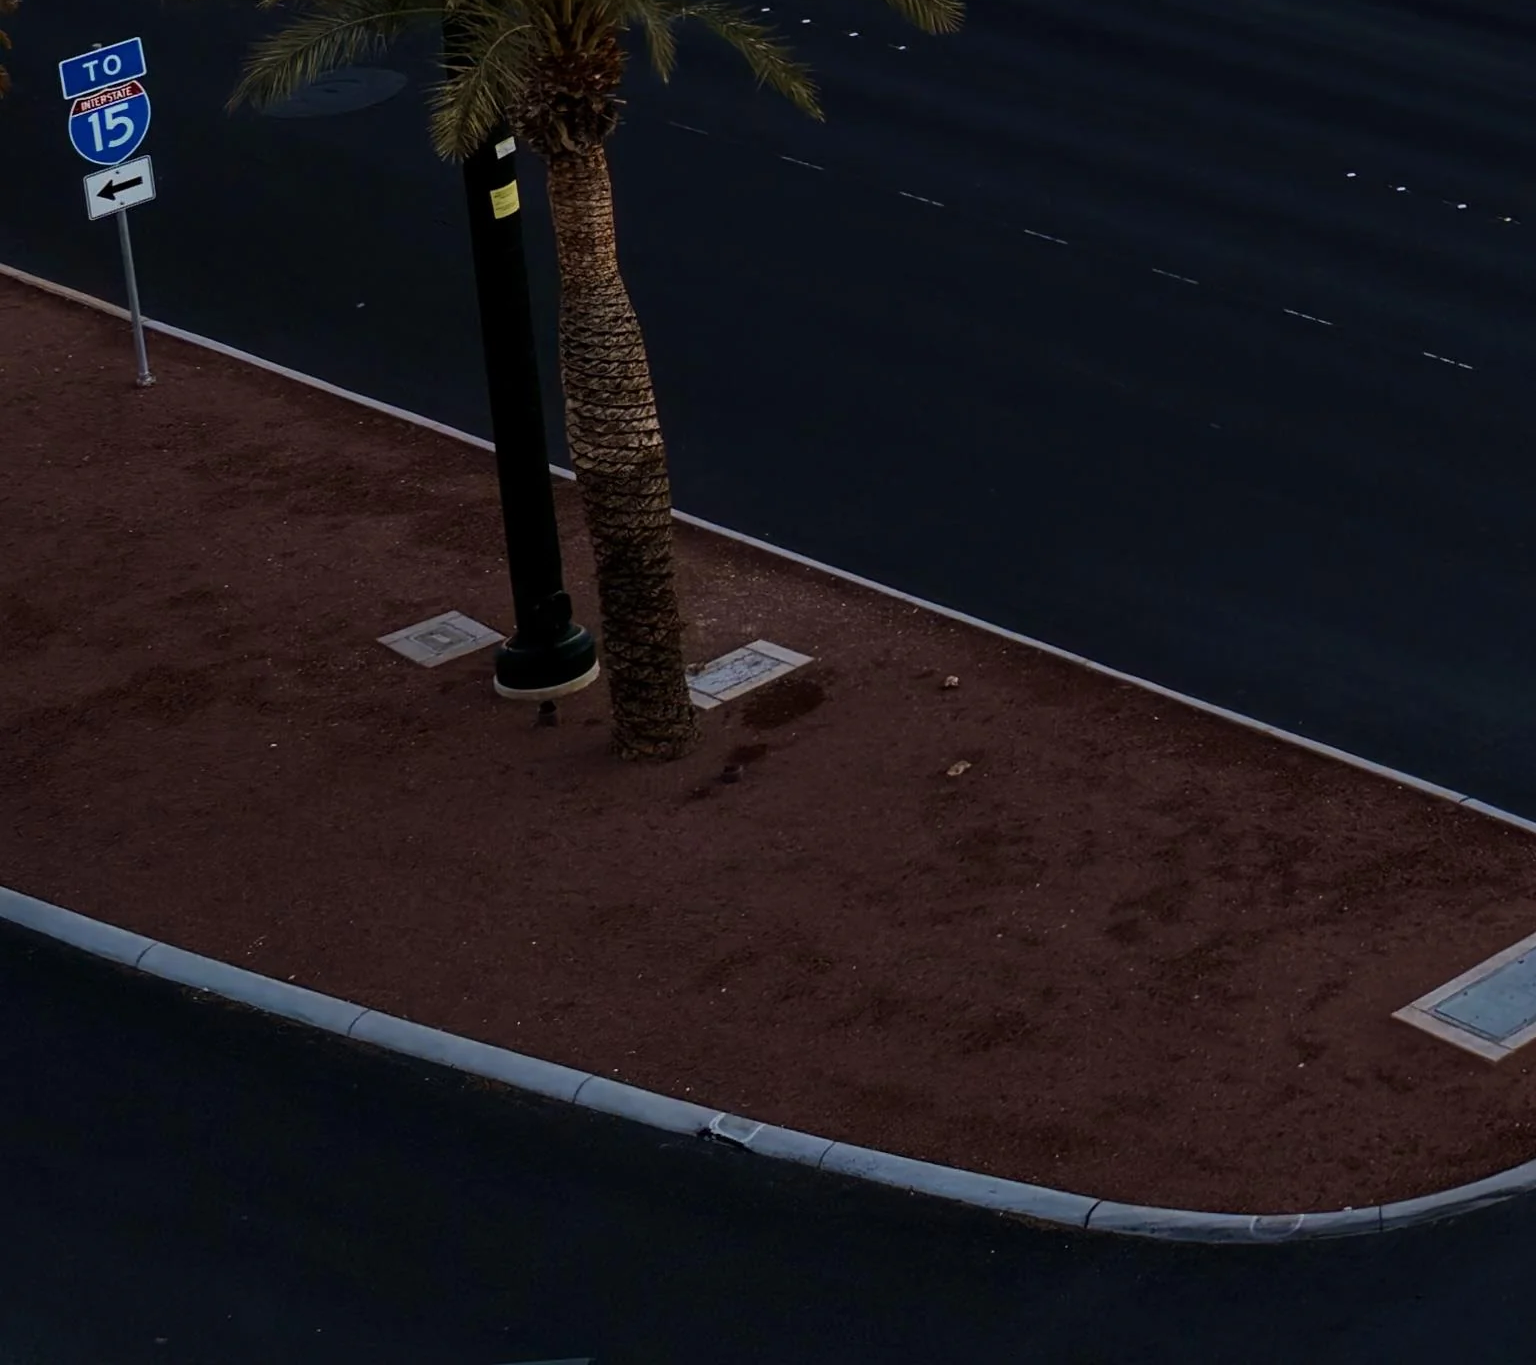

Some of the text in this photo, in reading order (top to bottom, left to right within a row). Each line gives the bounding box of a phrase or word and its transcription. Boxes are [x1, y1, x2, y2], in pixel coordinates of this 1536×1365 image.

[82, 54, 123, 82] TO
[80, 85, 134, 112] INTERSTATE
[87, 102, 135, 153] 15
